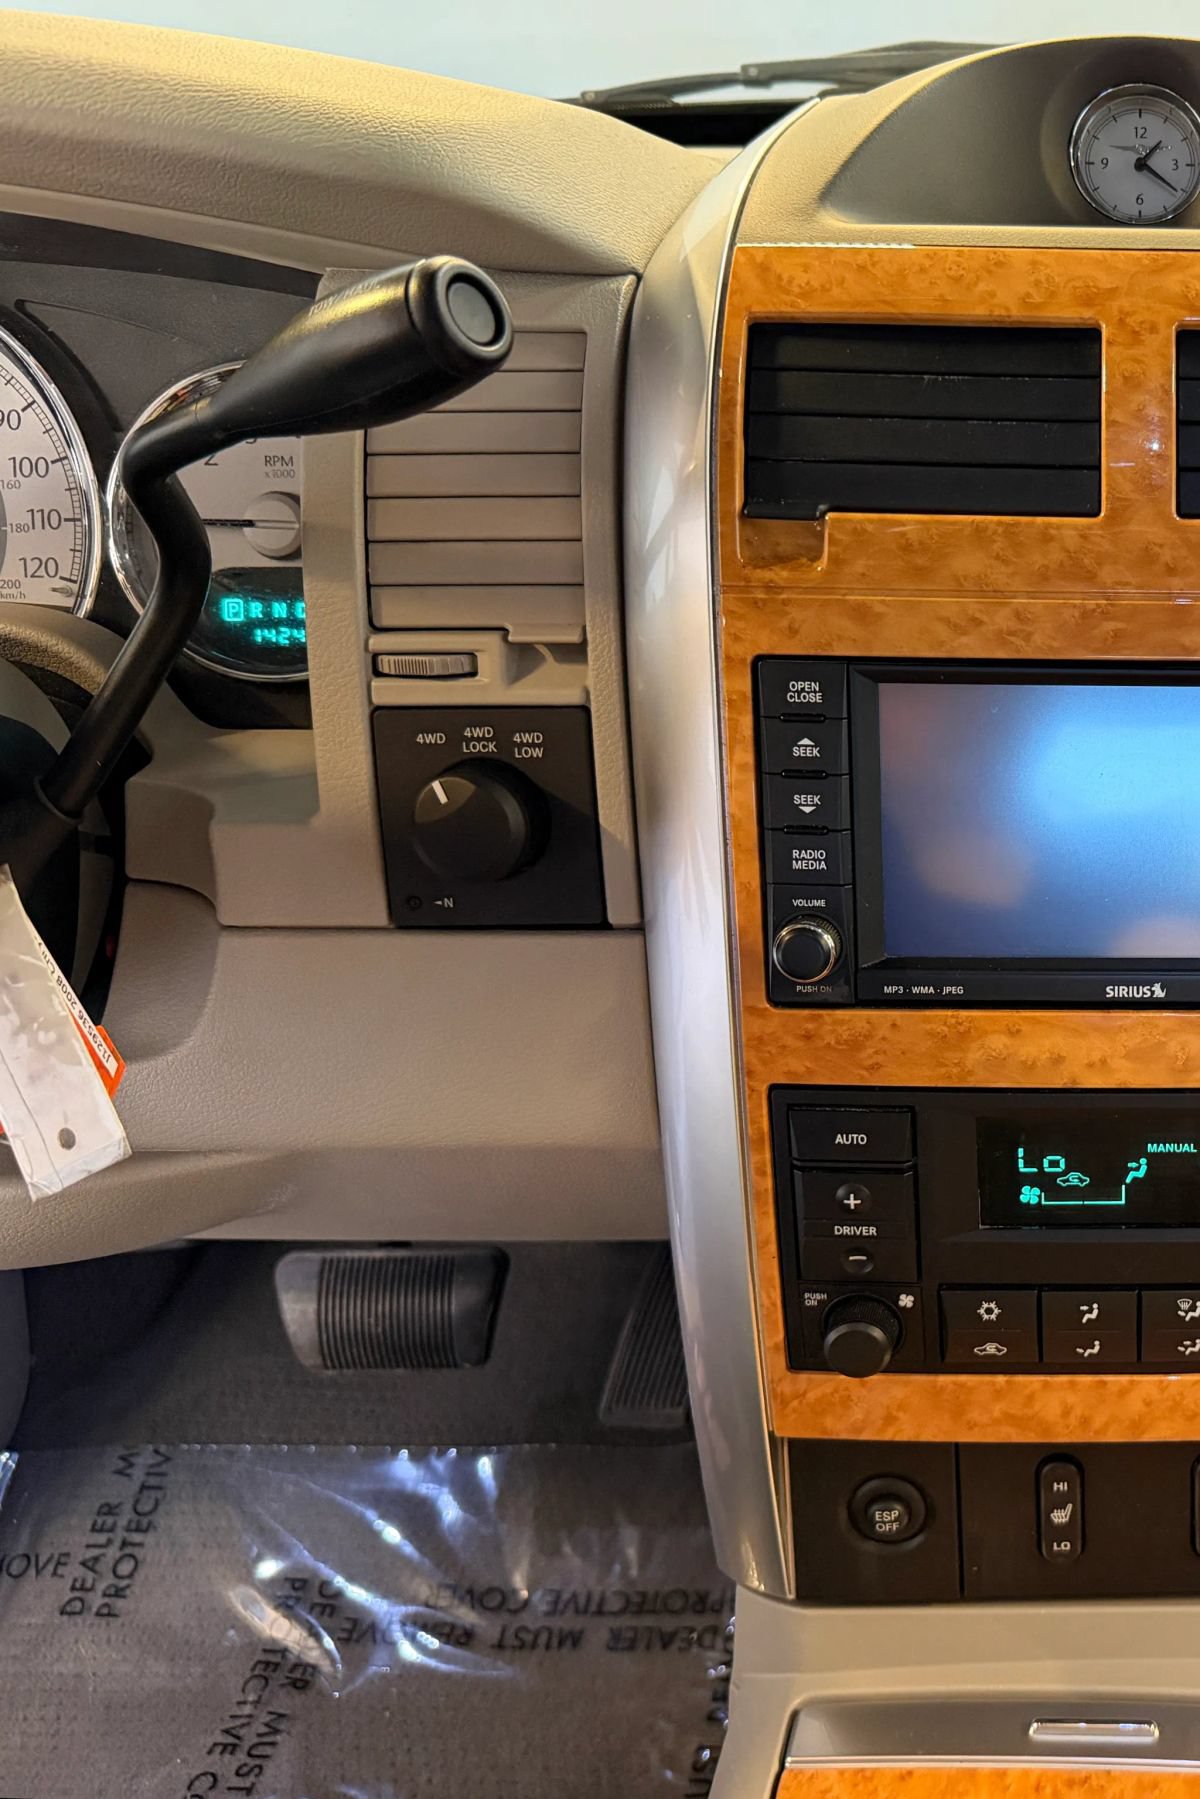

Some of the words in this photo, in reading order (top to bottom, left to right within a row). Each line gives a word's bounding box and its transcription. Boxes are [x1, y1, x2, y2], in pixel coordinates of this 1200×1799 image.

[1133, 126, 1148, 139] 12
[1100, 157, 1109, 170] 9
[1171, 158, 1179, 171] 3
[1135, 193, 1144, 206] 6
[264, 455, 294, 467] RPM
[8, 456, 50, 479] 100
[0, 480, 21, 490] 160
[25, 508, 62, 531] 110
[8, 522, 30, 533] 180
[18, 556, 60, 578] 120
[0, 579, 21, 589] 200
[247, 601, 263, 618] R
[271, 601, 288, 618] N
[788, 681, 820, 692] OPEN
[786, 692, 823, 703] CLOSE
[415, 732, 446, 744] 4WD
[463, 726, 494, 738] 4WD
[512, 731, 543, 744] 4WD
[462, 741, 498, 753] LOCK
[514, 747, 544, 759] LOW
[792, 746, 820, 757] SEEK
[793, 794, 821, 805] SEEK
[792, 849, 826, 860] RADIO
[792, 860, 827, 870] MEDIA
[792, 899, 826, 907] VOLUME
[55, 975, 77, 1010] 2008
[796, 985, 818, 993] PUSH
[819, 985, 832, 993] ON
[883, 985, 904, 994] MP3
[911, 986, 935, 995] WMA
[942, 985, 965, 995] JPEG
[1105, 985, 1152, 998] SIRIUS
[835, 1133, 867, 1145] AUTO
[1147, 1143, 1198, 1153] MANUAL
[834, 1225, 878, 1236] DRIVER
[804, 1292, 827, 1300] PUSH
[1053, 1481, 1068, 1491] HI
[875, 1510, 899, 1522] ESP
[875, 1522, 900, 1532] OFF
[95, 1449, 173, 1619] PROTECTIV
[1053, 1541, 1071, 1550] LO
[60, 1500, 122, 1618] DEALER
[0, 1552, 71, 1581] OVE
[542, 1587, 726, 1616] PROTECTIVE
[492, 1623, 585, 1651] MUST
[225, 1711, 288, 1797] MUST
